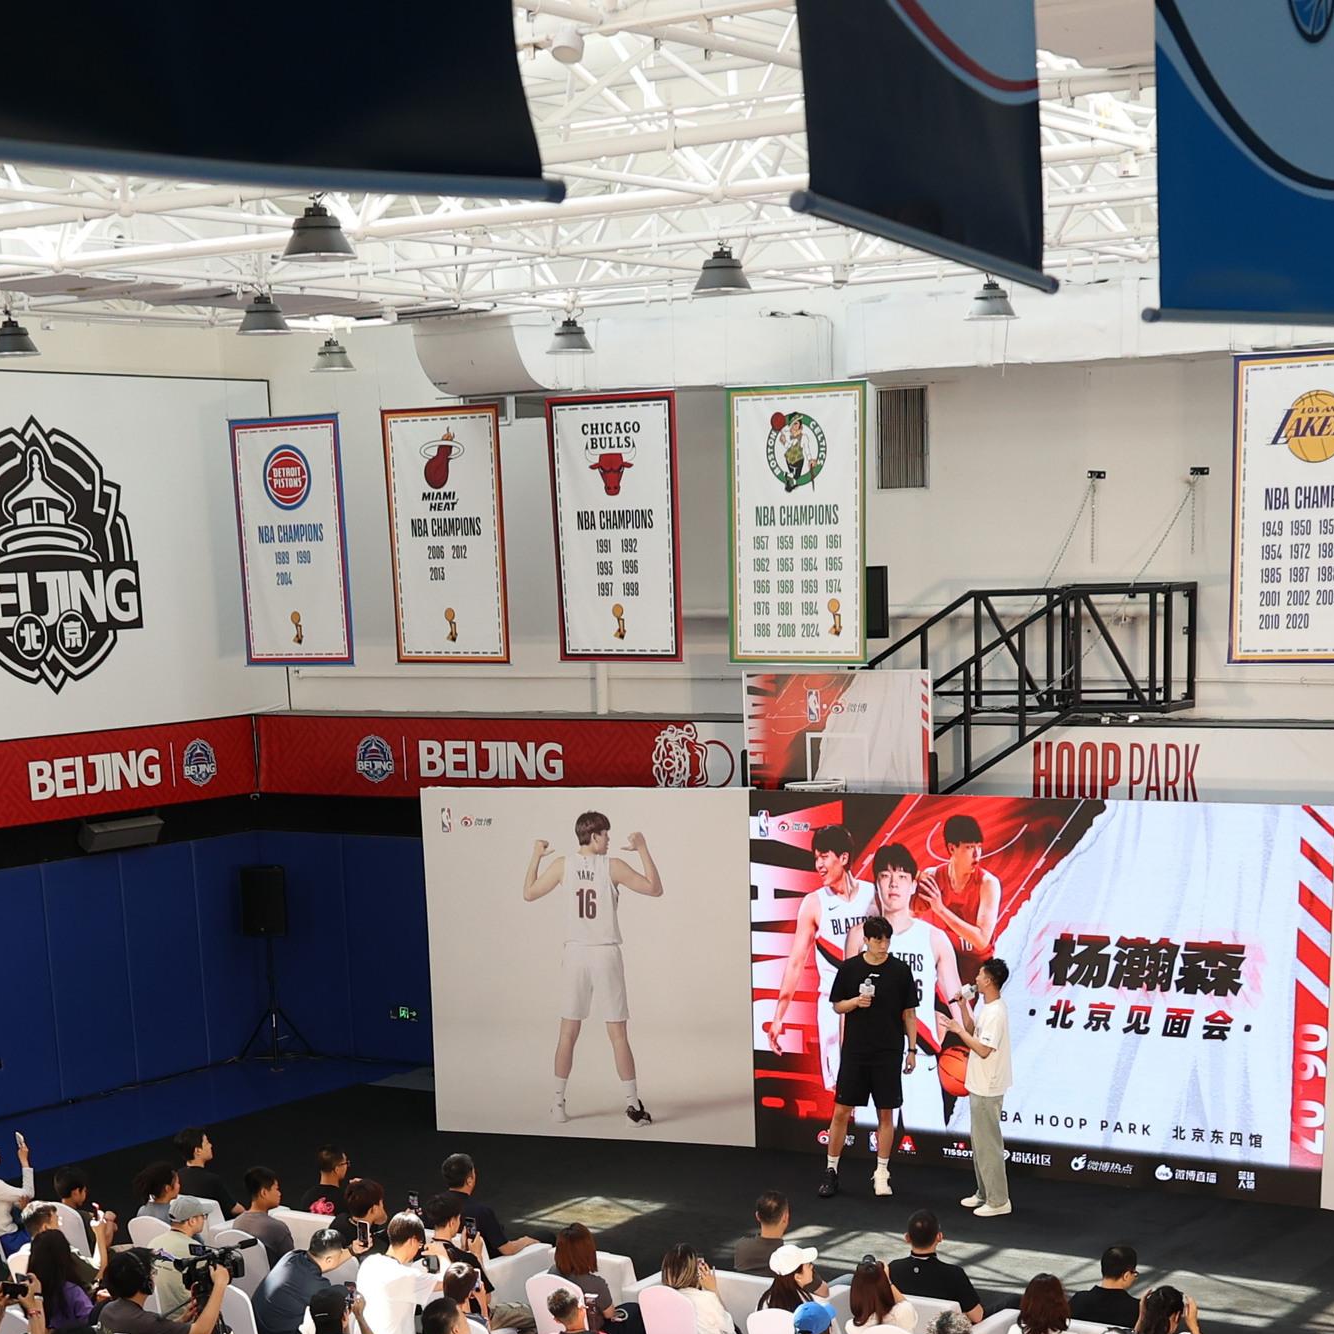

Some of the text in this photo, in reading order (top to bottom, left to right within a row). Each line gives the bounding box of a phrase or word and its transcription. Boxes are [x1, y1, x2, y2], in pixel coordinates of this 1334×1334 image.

[581, 421, 641, 436] CHICAGO
[590, 436, 633, 450] BULLS
[810, 420, 826, 466] CELTICS
[767, 430, 783, 478] BOSTON
[272, 466, 301, 478] DETROIT
[273, 477, 302, 489] PISTONS
[422, 491, 456, 501] MIAMI
[1264, 485, 1290, 510] NBA
[429, 499, 459, 511] HEAT
[577, 509, 654, 530] NBA CHAMPIONS
[755, 504, 839, 527] NBA CHAMPIONS
[258, 523, 324, 544] NBA CHAMPIONS
[411, 517, 482, 538] NBA CHAMPIONS
[1261, 519, 1284, 537] 1949
[1290, 519, 1312, 536] 1950
[596, 538, 638, 553] 1991 1992
[753, 534, 842, 550] 1957 1959 1960 1961
[275, 550, 311, 565] 1989 1990
[428, 545, 467, 560] 2006 2012
[1261, 543, 1283, 561] 1954
[1289, 542, 1311, 560] 1972
[596, 560, 639, 576] 1993 1996
[753, 556, 843, 572] 1962 1963 1964 1965
[276, 572, 292, 586] 2004
[429, 567, 445, 581] 2013
[1260, 566, 1282, 584] 1985
[1289, 566, 1310, 583] 1987
[597, 581, 639, 597] 1997 1998
[753, 578, 842, 594] 1966 1968 1969 1974
[1259, 590, 1281, 607] 2001
[1287, 589, 1310, 606] 2002
[753, 601, 818, 616] 1976 1981 1984
[1259, 612, 1309, 630] 2010 2020
[17, 620, 85, 654] 北京
[753, 623, 819, 638] 1986 2008 2024
[357, 760, 393, 772] BEIJING
[418, 740, 564, 782] BEIJING
[27, 748, 162, 802] BEIJING
[184, 763, 216, 777] BEIJING
[1033, 741, 1200, 801] HOOP PARK
[577, 870, 595, 882] YANG
[576, 889, 597, 919] 16
[1048, 932, 1246, 998] 杨瀚森
[999, 1110, 1152, 1136] BA HOOP PARK
[1172, 1125, 1263, 1148] 北京东四馆
[942, 1147, 974, 1158] TISSOT
[1011, 1150, 1052, 1166] 超话社区
[1086, 1160, 1134, 1175] 微博热点
[1174, 1168, 1217, 1184] 微博直播
